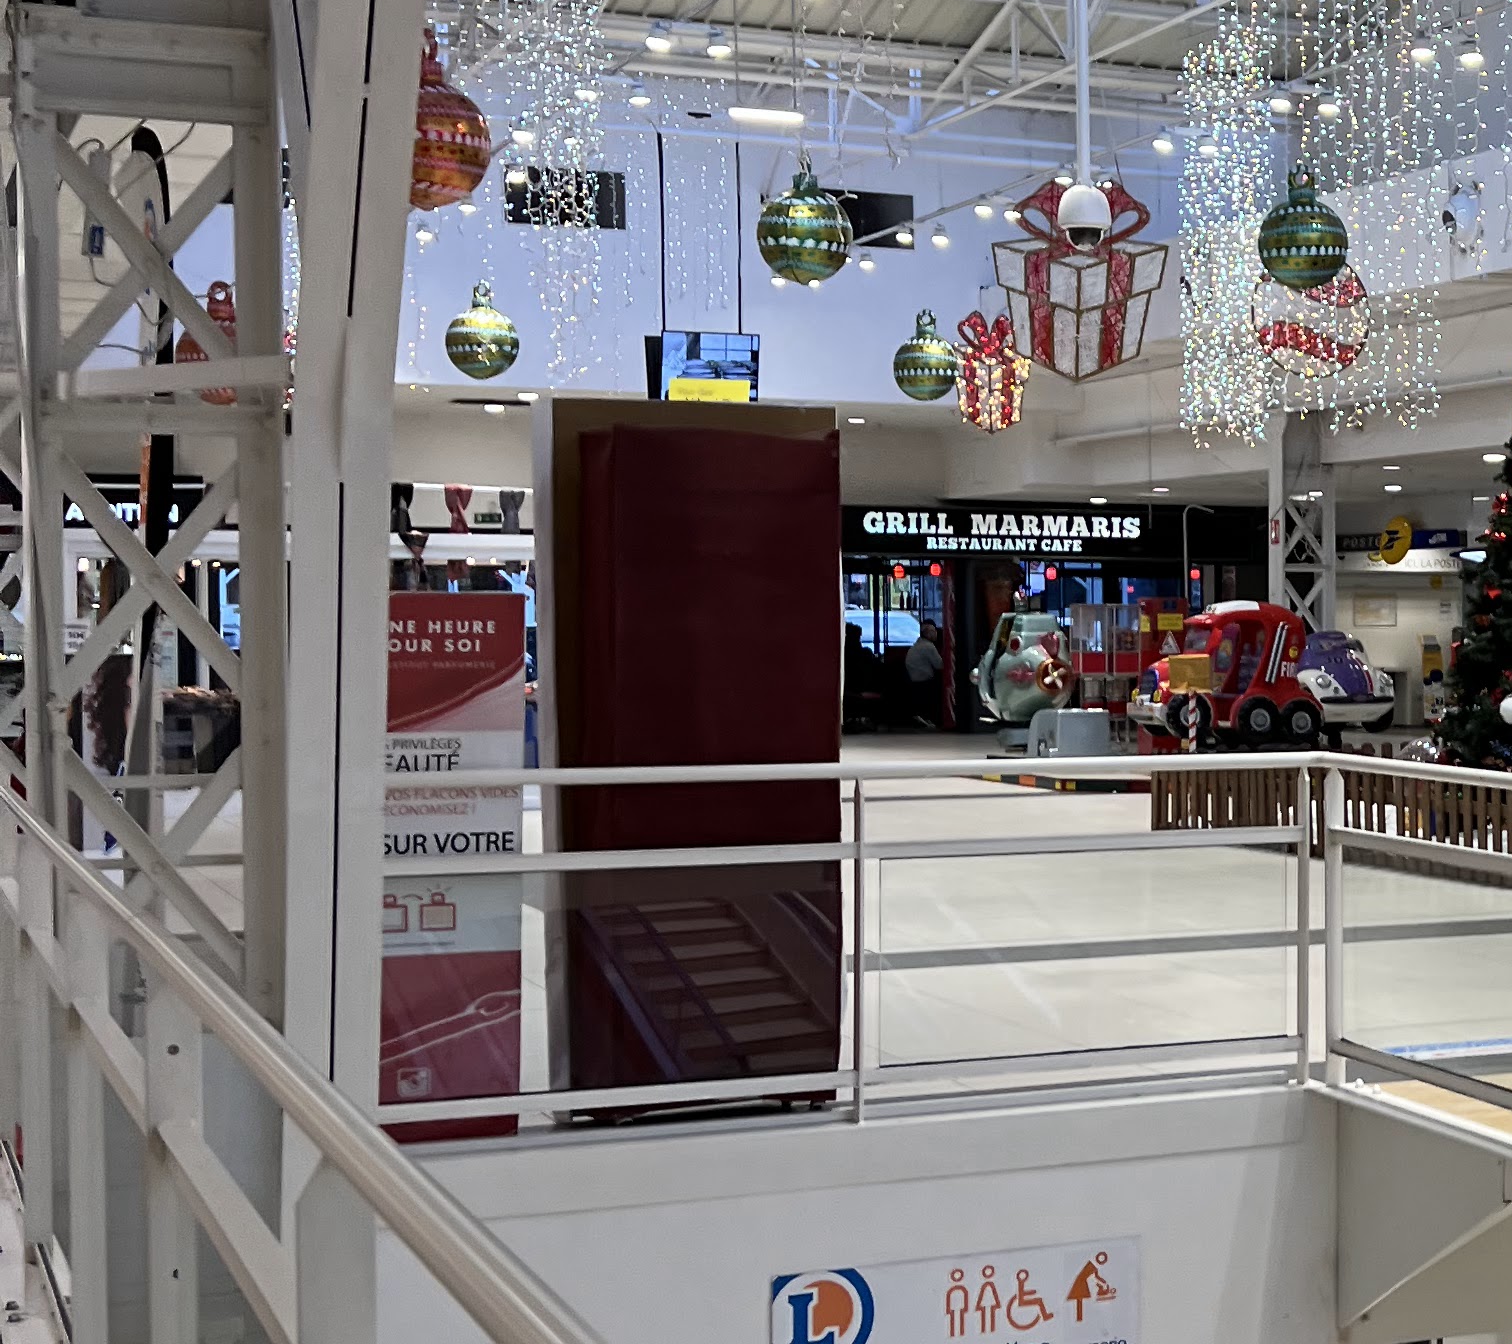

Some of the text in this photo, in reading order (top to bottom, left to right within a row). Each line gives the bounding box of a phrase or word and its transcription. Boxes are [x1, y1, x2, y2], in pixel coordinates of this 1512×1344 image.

[863, 511, 1141, 539] GRILL MARMARIS
[926, 536, 1083, 553] RESTAURANT CAFE
[387, 619, 497, 634] NE HEURE
[387, 637, 481, 653] OUR SOI
[392, 737, 462, 750] PRIVILÈGES
[433, 830, 515, 854] VOTRE
